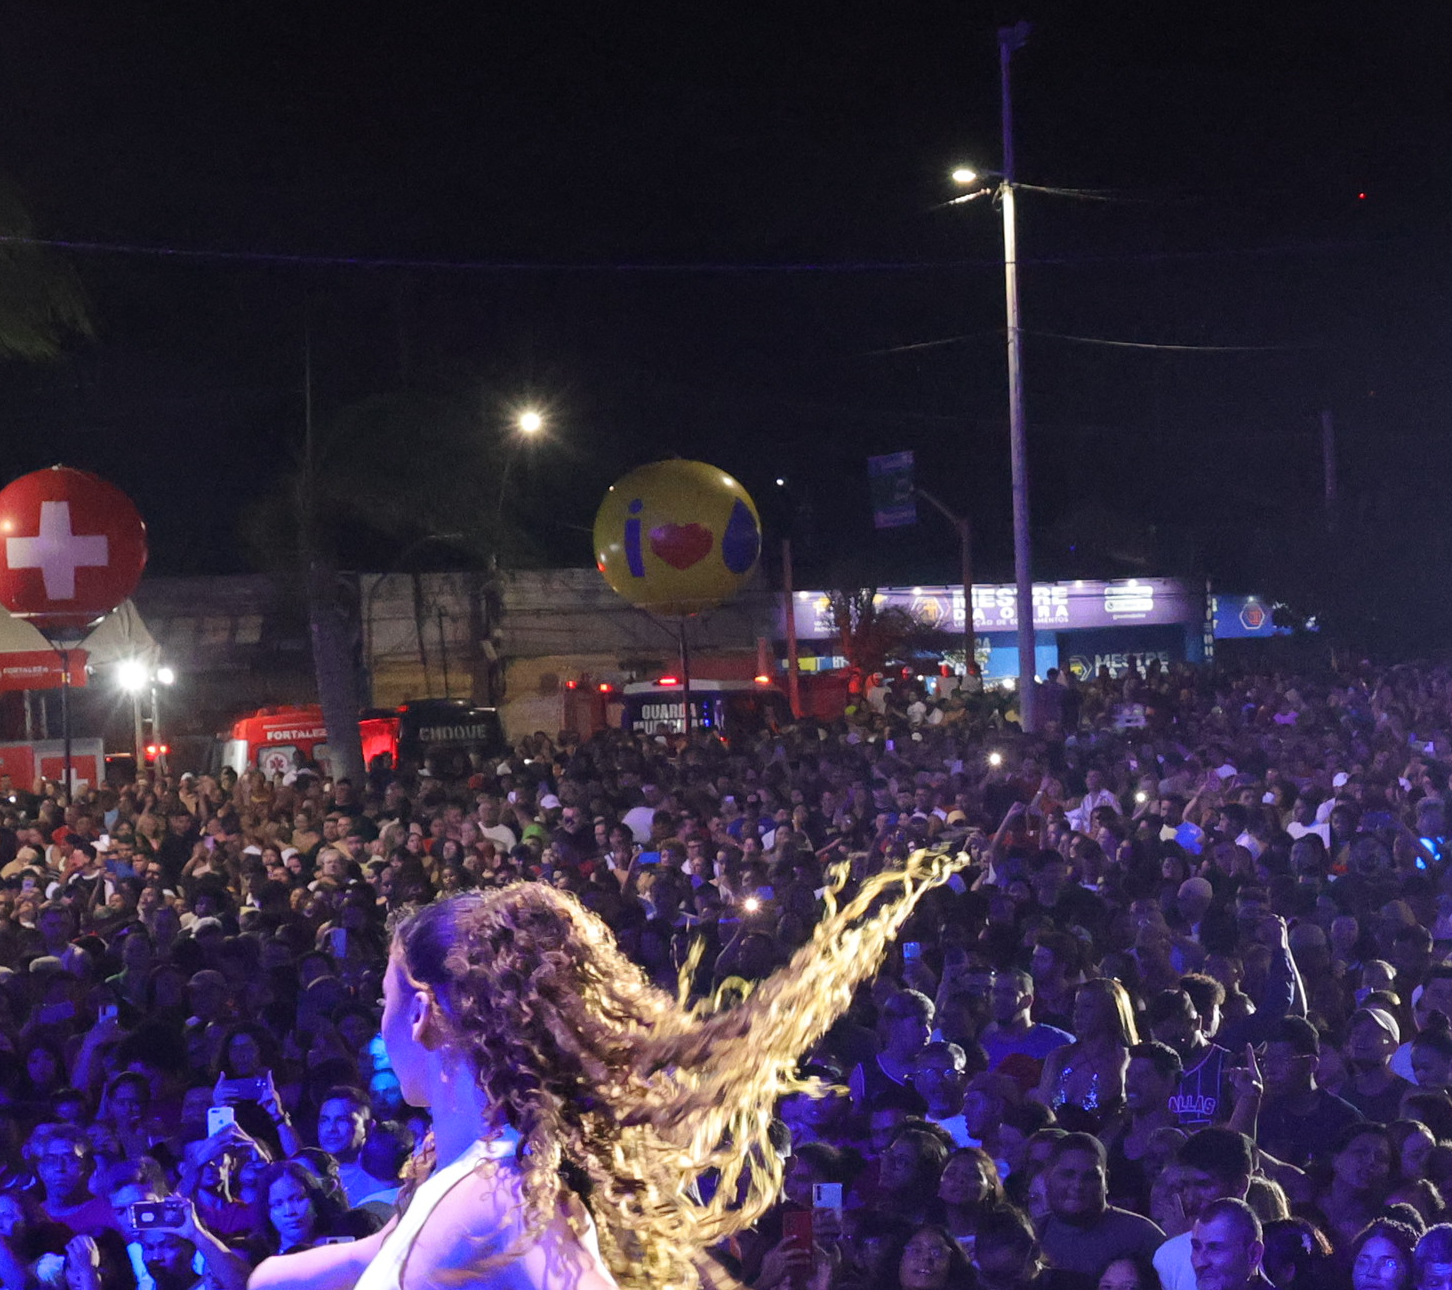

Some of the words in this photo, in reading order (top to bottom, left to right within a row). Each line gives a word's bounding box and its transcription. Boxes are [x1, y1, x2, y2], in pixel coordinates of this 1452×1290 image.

[952, 586, 1069, 609] MESRE
[999, 605, 1069, 619] ORA
[266, 728, 328, 741] FORTALEZ
